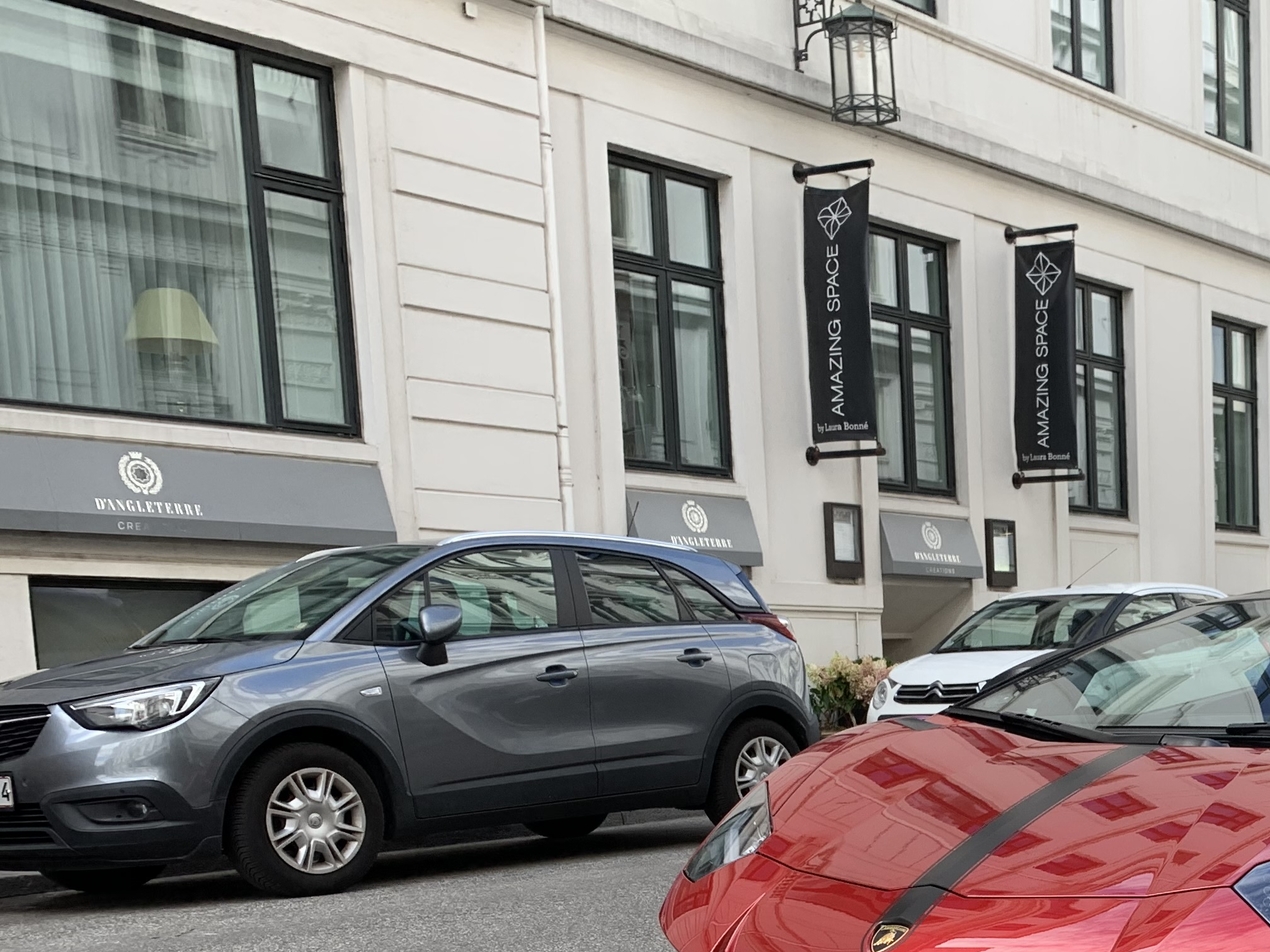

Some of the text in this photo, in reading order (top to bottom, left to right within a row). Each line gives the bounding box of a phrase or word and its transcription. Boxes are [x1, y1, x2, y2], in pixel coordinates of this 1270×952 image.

[826, 244, 845, 416] AMAZING SPACE
[1035, 299, 1050, 448] AMAZING SPACE
[817, 421, 869, 434] by Laura Bonné
[1022, 453, 1029, 464] by
[94, 498, 204, 517] D'ANGLETERRE
